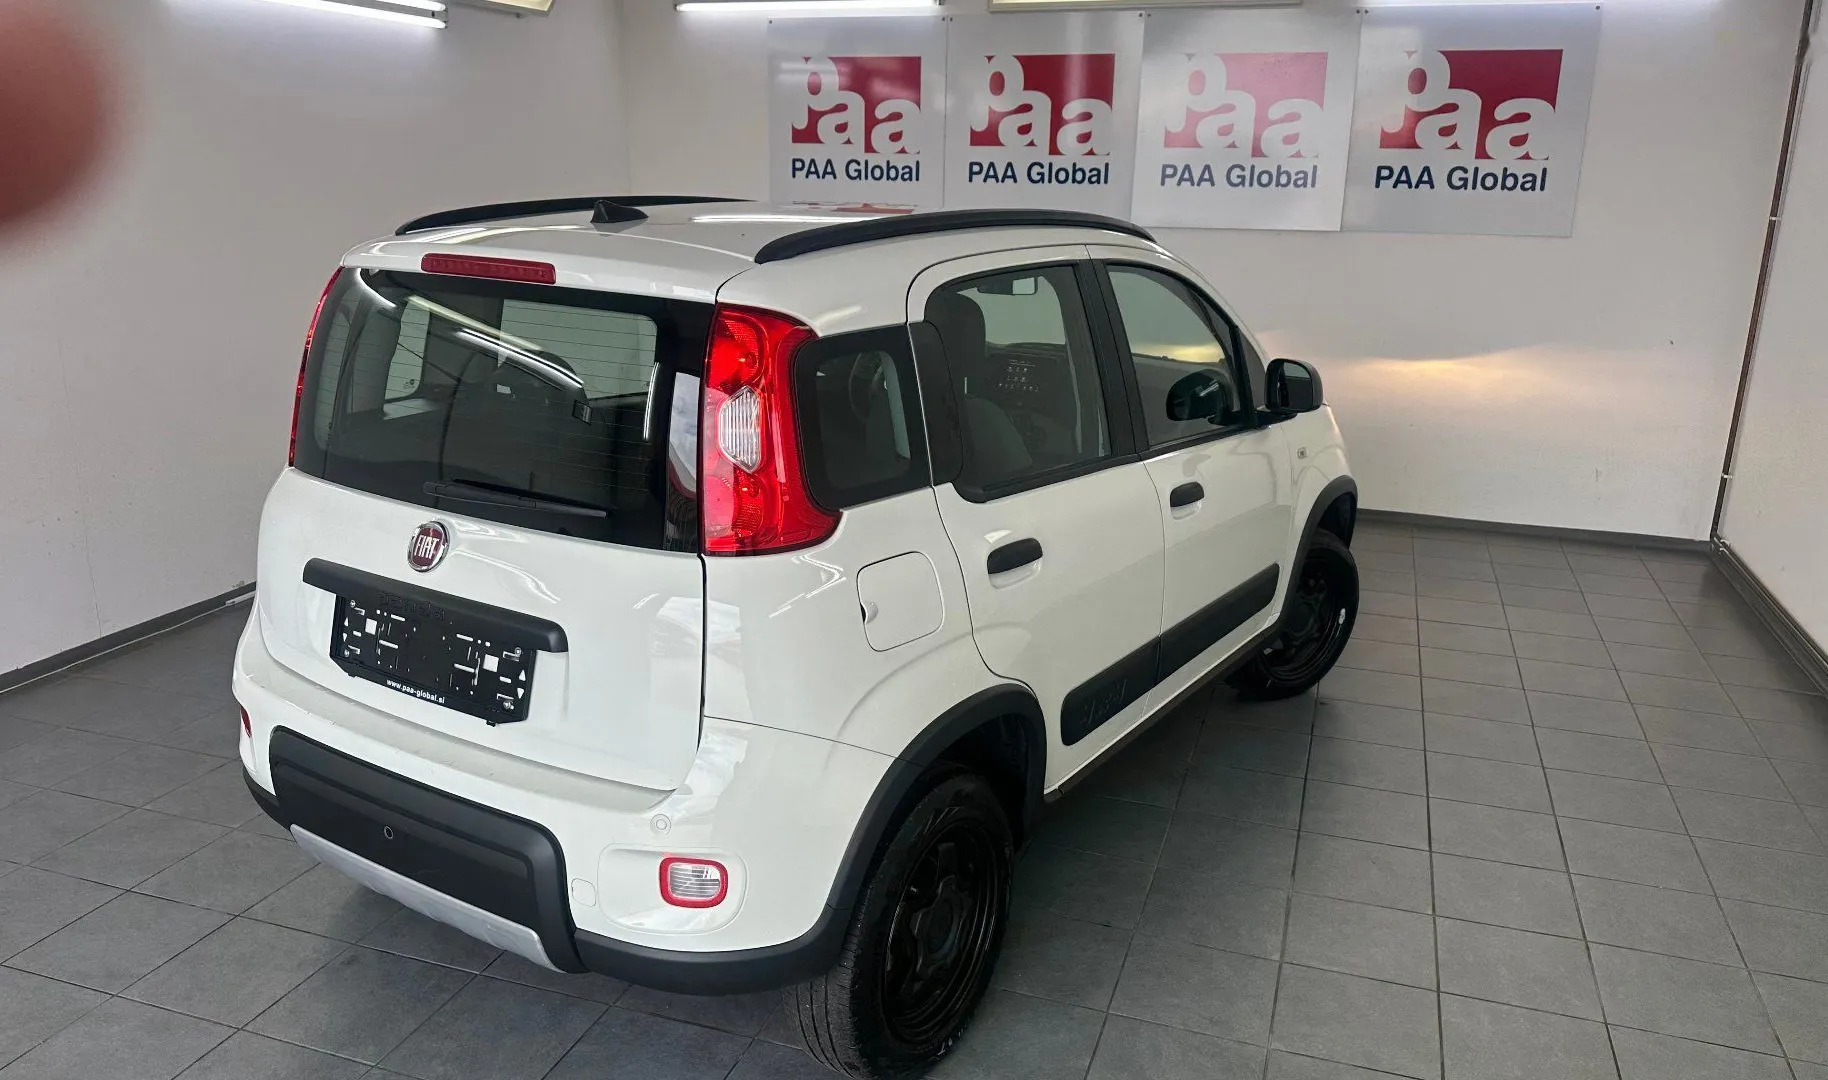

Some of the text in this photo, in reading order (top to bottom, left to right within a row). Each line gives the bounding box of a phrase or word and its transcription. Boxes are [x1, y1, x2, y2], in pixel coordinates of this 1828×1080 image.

[791, 158, 921, 183] PAA Global
[968, 161, 1110, 185] PAA Global
[1160, 164, 1318, 189] PAA Global
[1374, 165, 1548, 192] PAA Global
[414, 534, 440, 560] FIAT
[386, 679, 446, 704] www.paa-global.si
